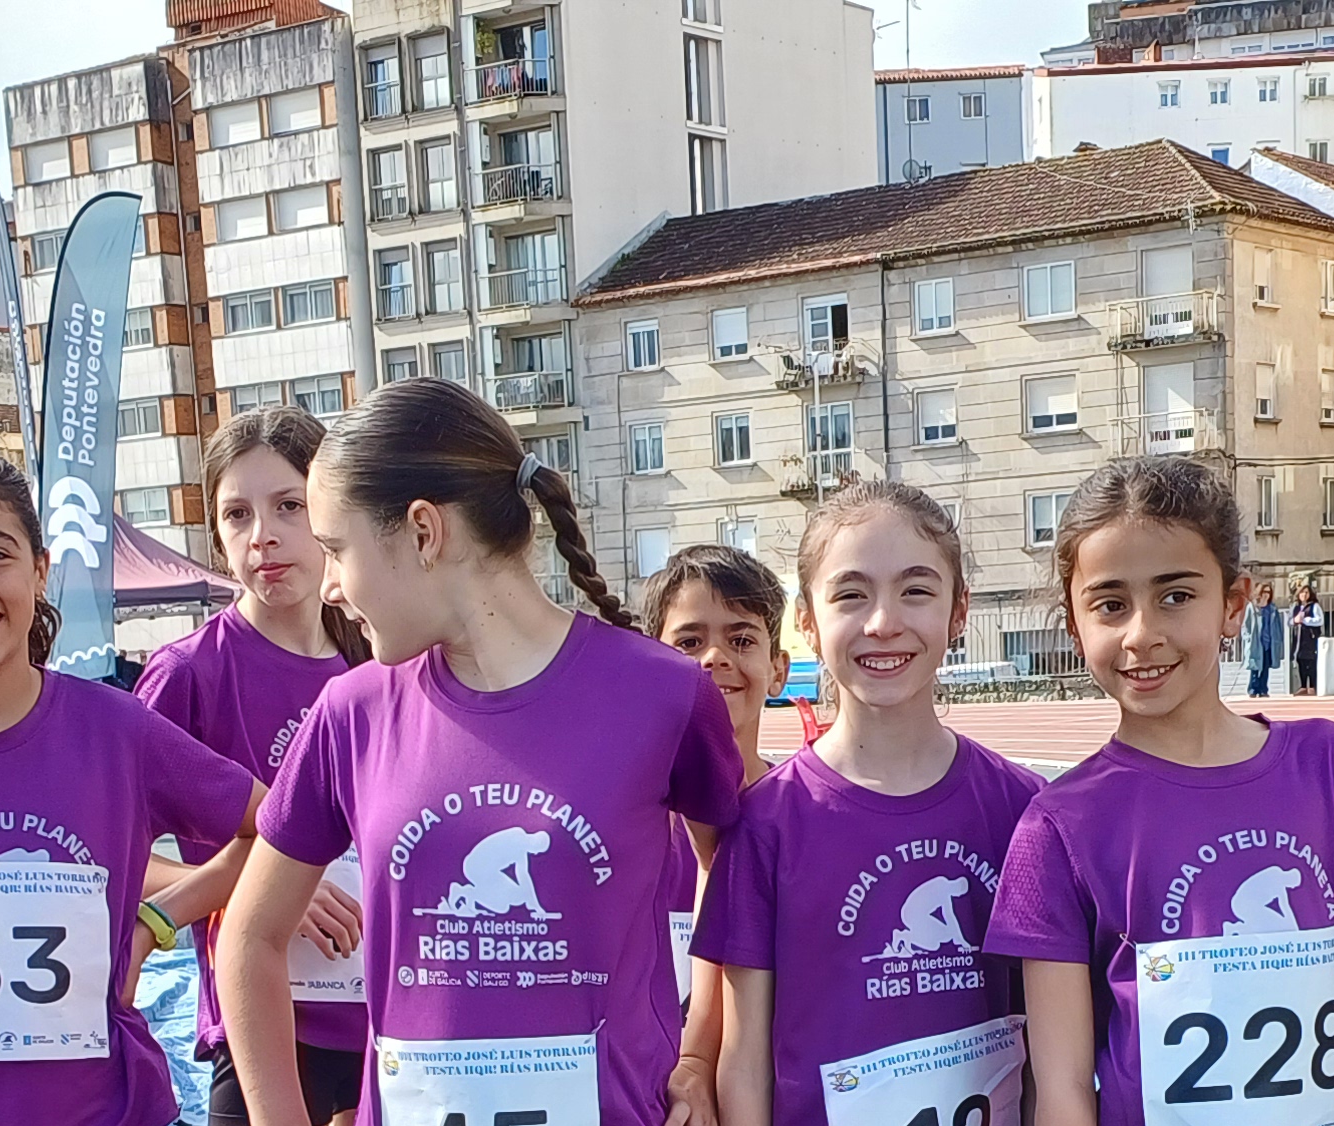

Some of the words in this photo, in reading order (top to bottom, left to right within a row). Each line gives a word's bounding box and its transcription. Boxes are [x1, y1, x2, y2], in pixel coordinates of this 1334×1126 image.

[58, 303, 86, 461] Deputación
[78, 308, 105, 466] Pontevedra
[267, 718, 300, 768] COIDA
[389, 808, 441, 881] COIDA
[444, 793, 462, 815] O
[469, 783, 520, 807] TEU
[526, 788, 612, 886] PLANETA
[24, 882, 52, 894] RÍAS
[55, 884, 92, 894] BAIXAS
[25, 872, 53, 881] LUIS
[838, 871, 878, 936] COIDA
[875, 855, 893, 873] O
[895, 839, 938, 863] TEU
[944, 840, 1001, 893] PLANE
[1161, 863, 1202, 934] COIDA
[1198, 844, 1217, 863] O
[1218, 829, 1267, 853] TEU
[436, 919, 469, 935] Club
[472, 920, 548, 936] Atletismo
[419, 935, 470, 960] Rías
[478, 936, 568, 961] Baixas
[1178, 951, 1196, 962] III
[1199, 946, 1258, 959] TROFEO
[1260, 941, 1294, 955] JOSÉ
[1297, 942, 1322, 953] LUIS
[883, 961, 908, 974] Club
[912, 955, 973, 971] Atletismo
[1214, 960, 1257, 973] FESTA
[1296, 954, 1321, 967] RÍAS
[867, 976, 911, 1000] Rías
[917, 969, 984, 993] Baixas
[414, 1052, 462, 1062] TROFEO
[464, 1048, 498, 1060] JOSÉ
[501, 1050, 532, 1060] LUIS
[533, 1045, 595, 1058] TORRADO
[861, 1063, 877, 1075] III
[878, 1048, 931, 1069] TROFEO
[933, 1040, 962, 1056] JOSÉ
[962, 1035, 984, 1049] LUIS
[893, 1062, 932, 1077] FESTA
[963, 1050, 984, 1063] RÍAS
[985, 1038, 1015, 1055] BAIXAS
[424, 1065, 462, 1076] FESTA
[500, 1061, 531, 1074] RÍAS
[534, 1061, 578, 1073] BAIXAS
